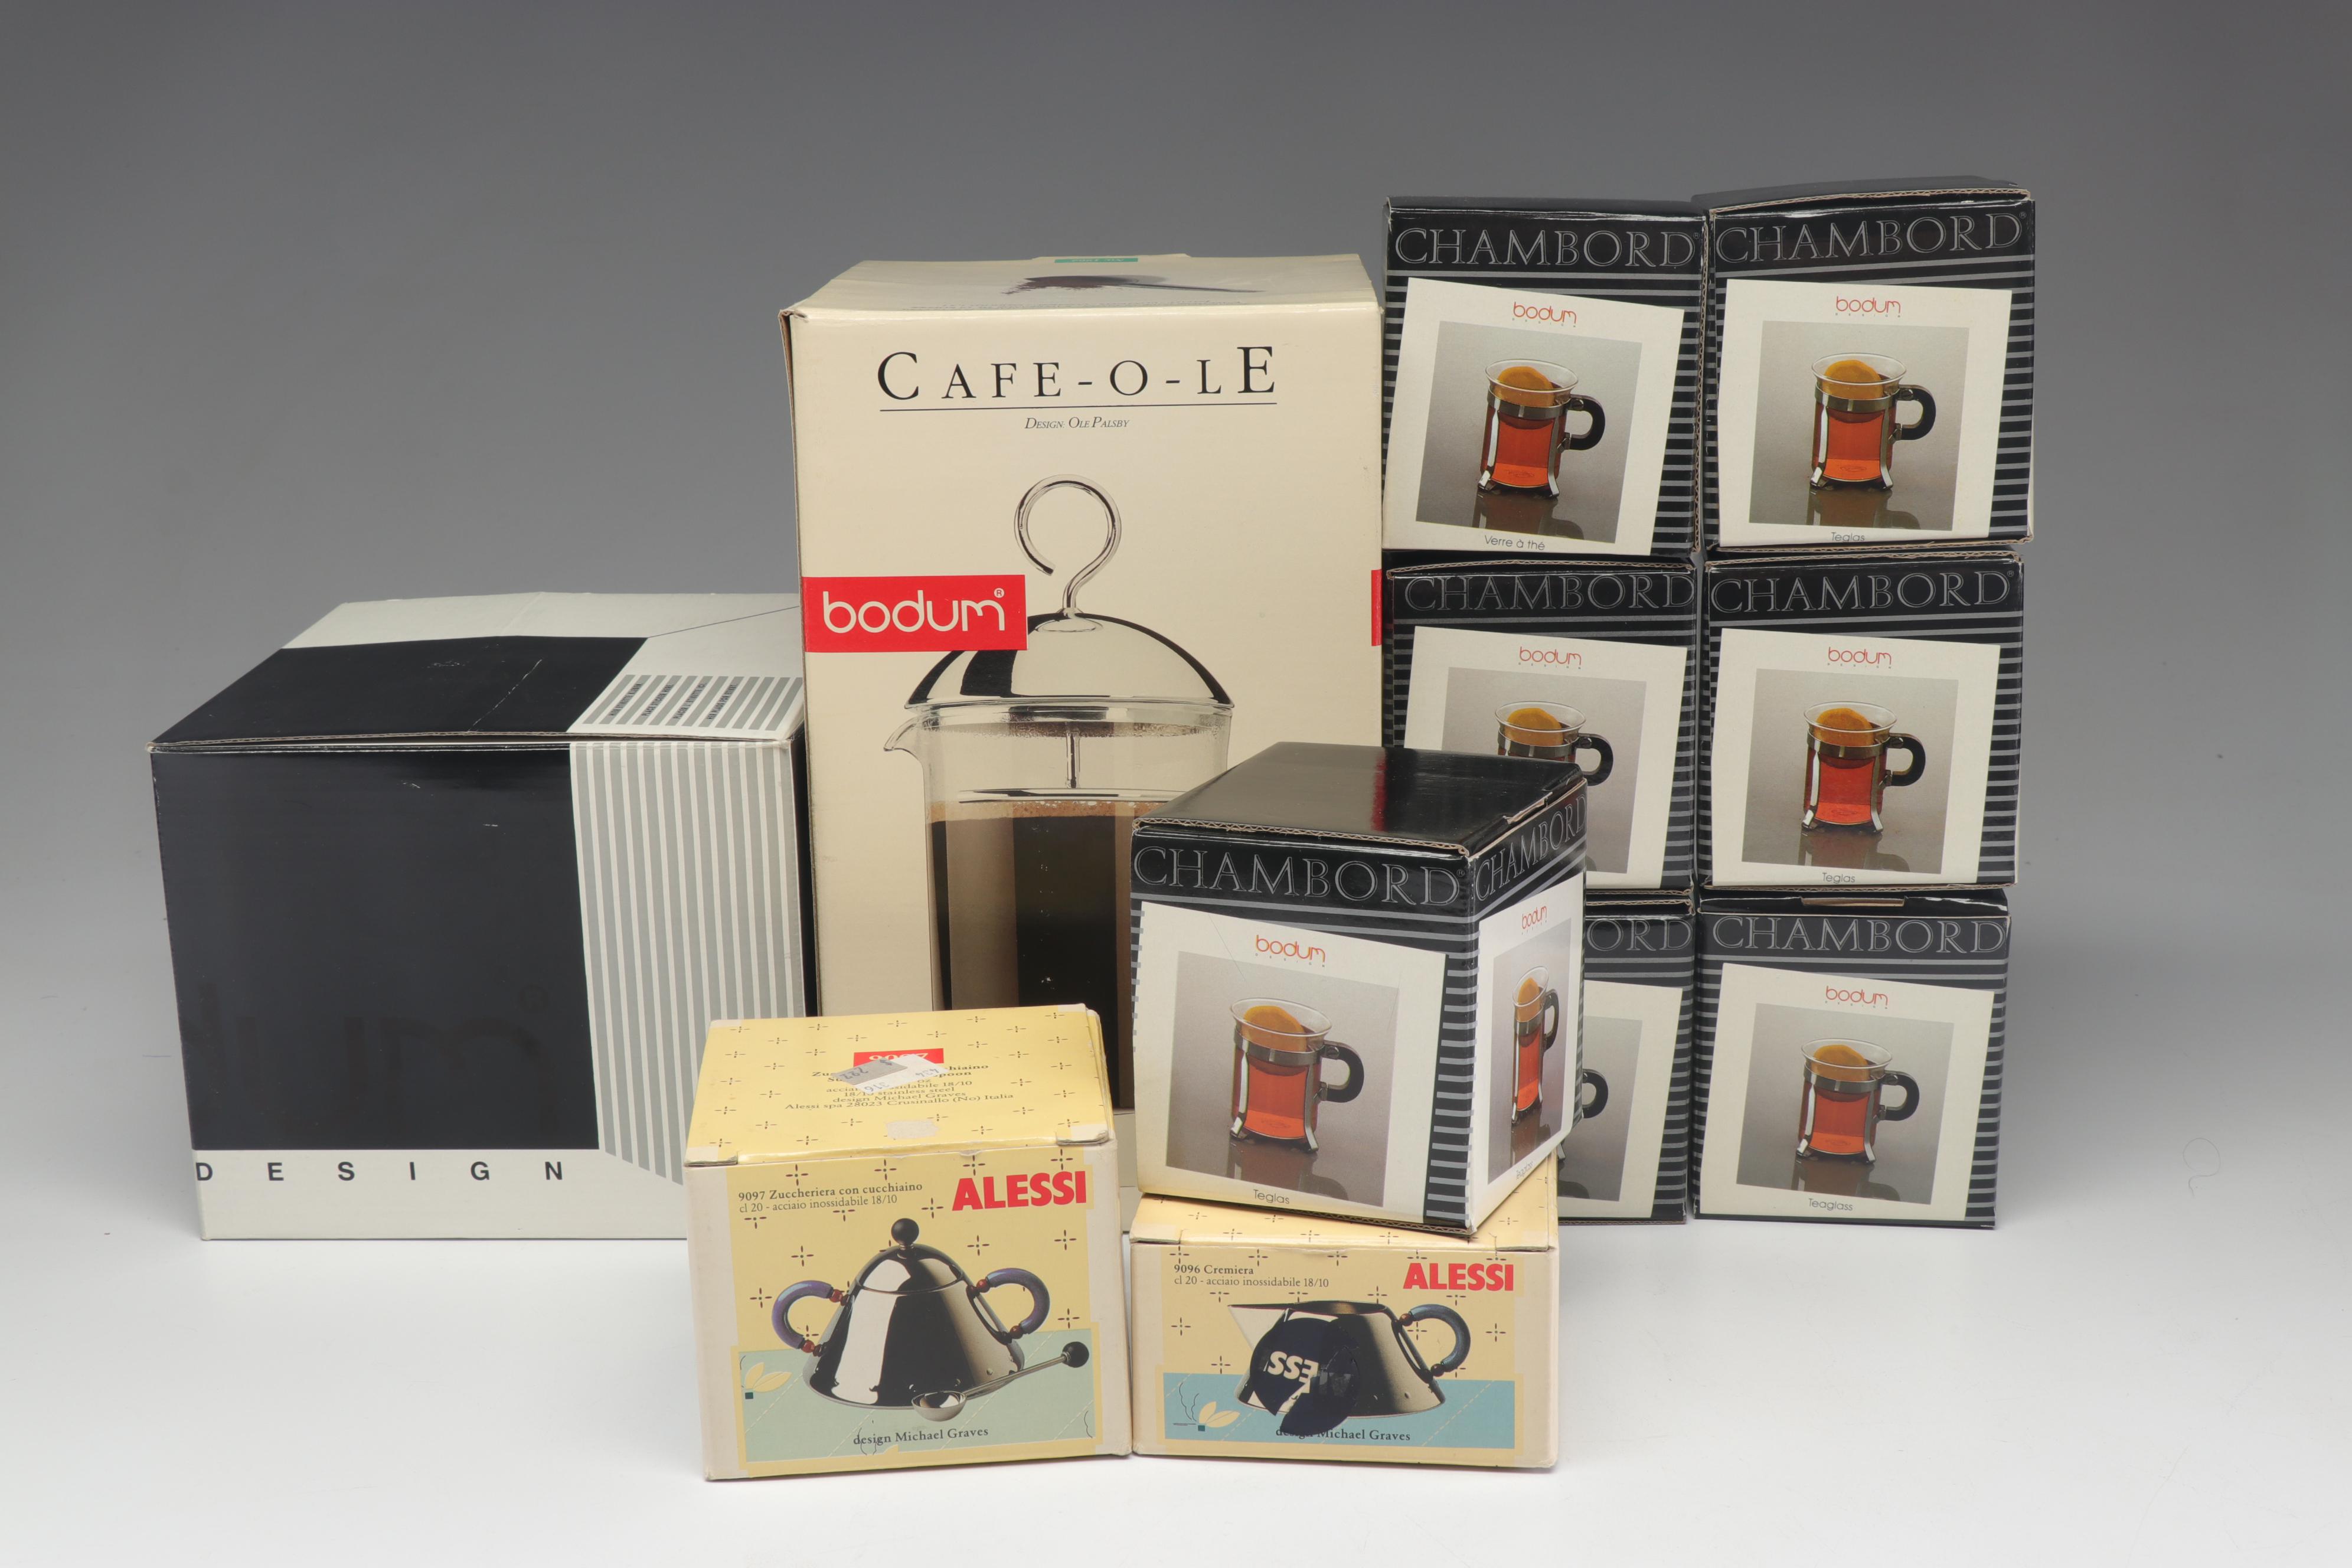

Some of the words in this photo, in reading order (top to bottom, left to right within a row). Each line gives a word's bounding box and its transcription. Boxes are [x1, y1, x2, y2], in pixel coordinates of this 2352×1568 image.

[1513, 301, 1577, 324] bodum
[1836, 295, 1900, 313] bodum
[1069, 416, 1090, 428] OLE
[1092, 416, 1130, 428] PALSBY
[1485, 535, 1513, 547] Verre
[1516, 540, 1524, 548] à
[1527, 540, 1545, 550] thé
[1831, 531, 1866, 543] Teglas
[1404, 573, 1696, 611] CHAMBORD
[1520, 646, 1582, 666] bodum
[1828, 646, 1892, 665] bodum
[1476, 793, 1586, 901] CHAMBORD
[1822, 872, 1856, 884] Teglas
[1521, 906, 1547, 930] bodum
[1256, 935, 1325, 963] bodum
[1826, 985, 1888, 1006] bodum
[887, 1097, 949, 1106] Crusinallo
[195, 1161, 563, 1182] DESIGN
[739, 1191, 765, 1201] 9097
[769, 1187, 835, 1200] Zuccheriera
[863, 1181, 923, 1194] cucchiaino
[952, 1170, 1087, 1211] ALESSI
[1253, 1188, 1289, 1205] Teglas
[739, 1204, 747, 1213] cl
[751, 1203, 763, 1211] 20
[772, 1201, 806, 1211] acciaio
[810, 1197, 868, 1208] inossidabile
[871, 1194, 898, 1205] 18/10
[1808, 1198, 1853, 1211] Teaglass
[1174, 1264, 1200, 1274] 9096
[1204, 1265, 1254, 1275] Cremiera
[1403, 1262, 1514, 1292] ALESSI
[1174, 1275, 1182, 1285] cl
[1185, 1276, 1197, 1285] 20
[1206, 1276, 1240, 1286] acciaio
[1243, 1276, 1301, 1287] inossidabile
[1304, 1278, 1329, 1288] 18/10
[853, 1433, 892, 1446] design
[895, 1429, 943, 1442] Michael
[948, 1427, 989, 1439] Graves
[1370, 1430, 1410, 1440] Graves
